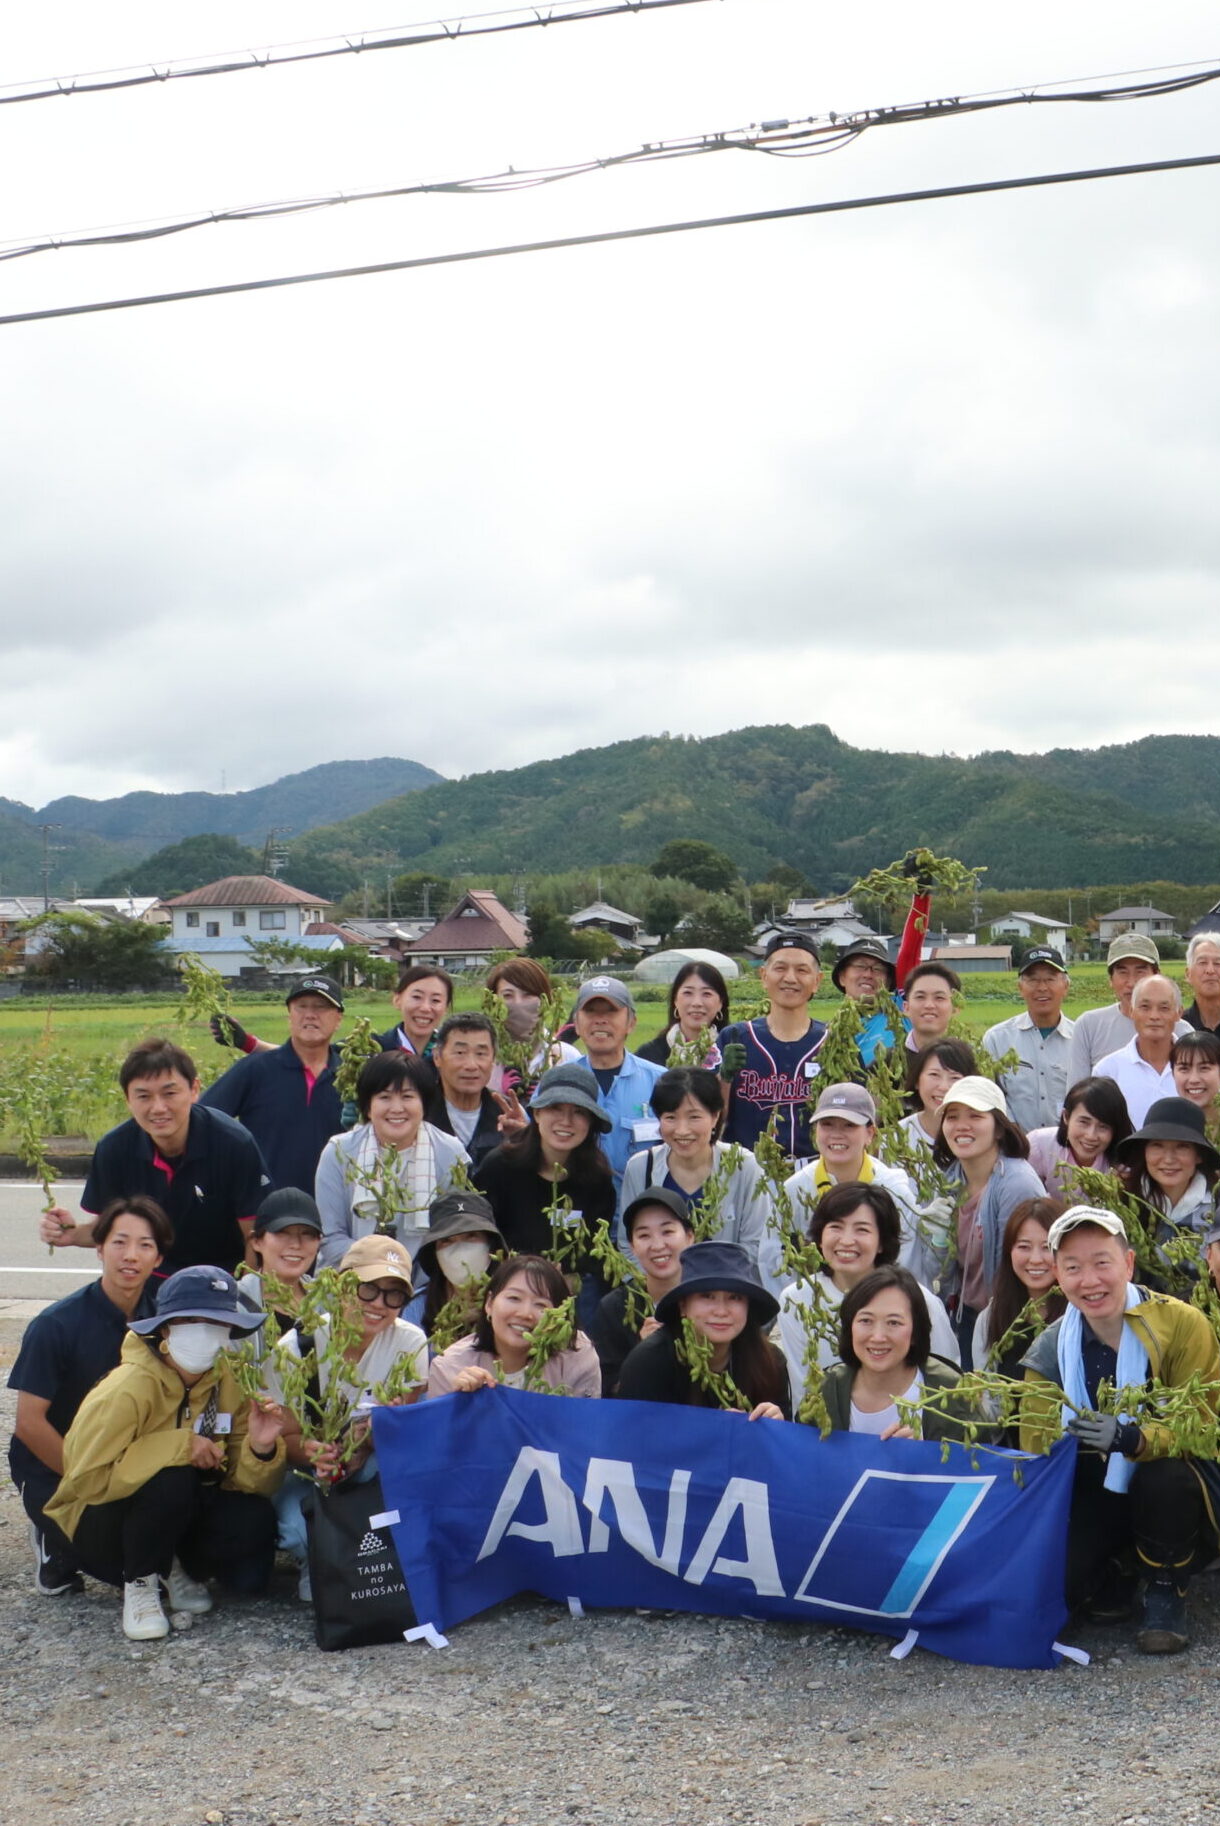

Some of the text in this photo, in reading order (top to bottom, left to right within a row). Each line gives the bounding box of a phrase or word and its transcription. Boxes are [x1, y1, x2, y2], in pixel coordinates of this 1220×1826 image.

[475, 1445, 787, 1598] ANA
[357, 1562, 394, 1576] TAMBA
[370, 1576, 384, 1585] no
[351, 1583, 407, 1600] KUROSAYA
